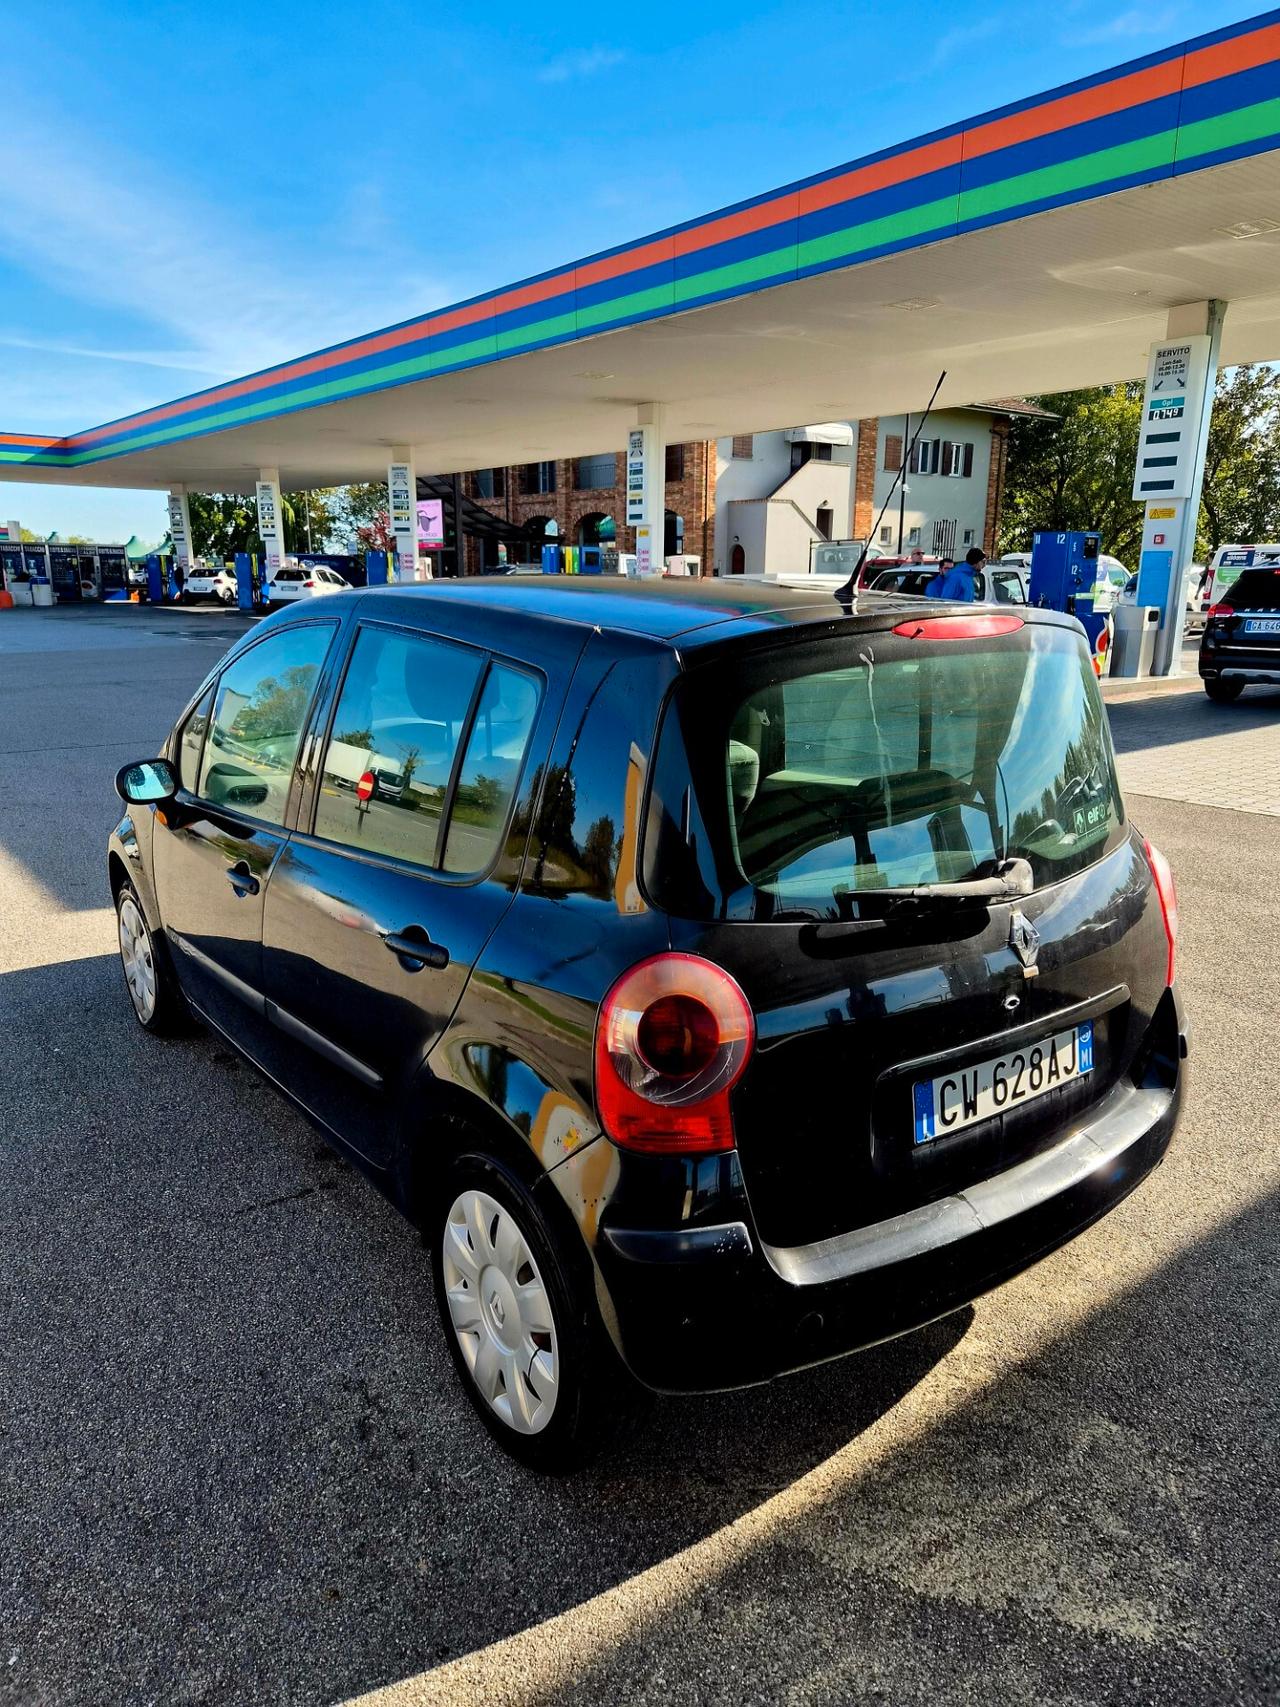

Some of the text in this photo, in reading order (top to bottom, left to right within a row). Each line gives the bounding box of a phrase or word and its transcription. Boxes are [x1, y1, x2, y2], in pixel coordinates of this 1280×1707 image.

[1157, 347, 1190, 358] SERVITO
[1056, 533, 1066, 545] 12
[1071, 565, 1078, 575] 12
[1088, 806, 1099, 824] elf
[1081, 1047, 1093, 1068] MI
[939, 1031, 1076, 1126] CW 628AJ
